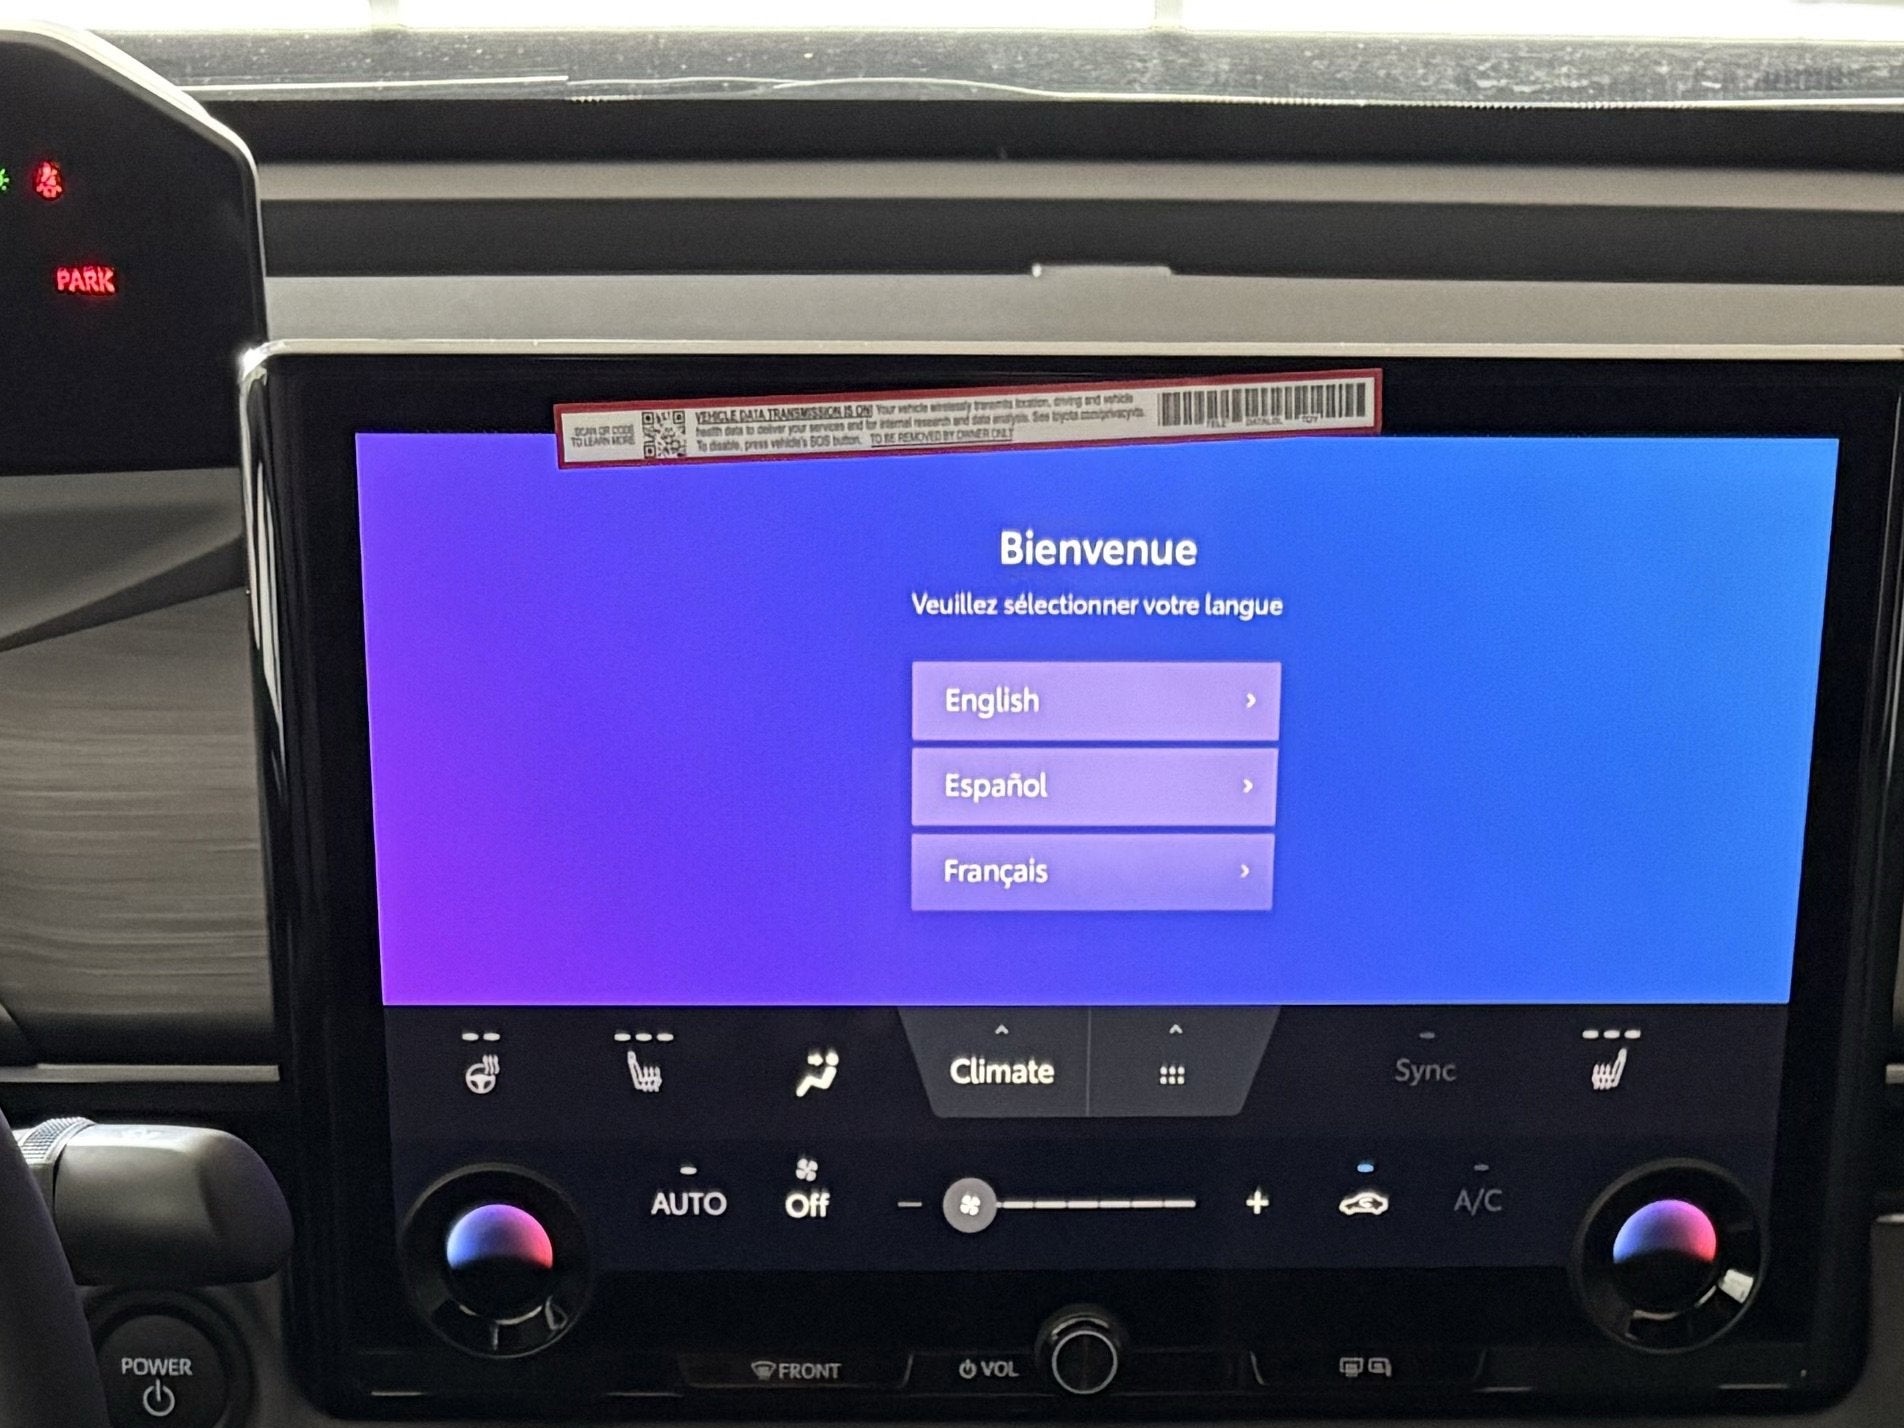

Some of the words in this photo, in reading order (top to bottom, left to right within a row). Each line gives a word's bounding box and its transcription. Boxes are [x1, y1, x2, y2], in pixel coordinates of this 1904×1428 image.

[56, 266, 116, 293] PARK
[695, 410, 737, 424] VEHICLE
[740, 408, 766, 421] DATA
[1000, 528, 1198, 566] Bienvenue
[911, 591, 998, 616] Veuillez
[1003, 591, 1139, 616] sélectionner
[1143, 595, 1200, 616] votre
[1205, 592, 1283, 621] langue
[945, 686, 1040, 719] English
[944, 771, 1048, 803] Español
[943, 857, 1049, 889] Français
[949, 1057, 1054, 1085] Climate
[1394, 1058, 1457, 1084] Sync
[650, 1192, 727, 1217] AUTO
[785, 1191, 830, 1218] Off
[1454, 1189, 1504, 1215] A/C
[120, 1357, 193, 1376] POWER
[778, 1362, 842, 1381] FRONT
[981, 1360, 1019, 1378] VOL
